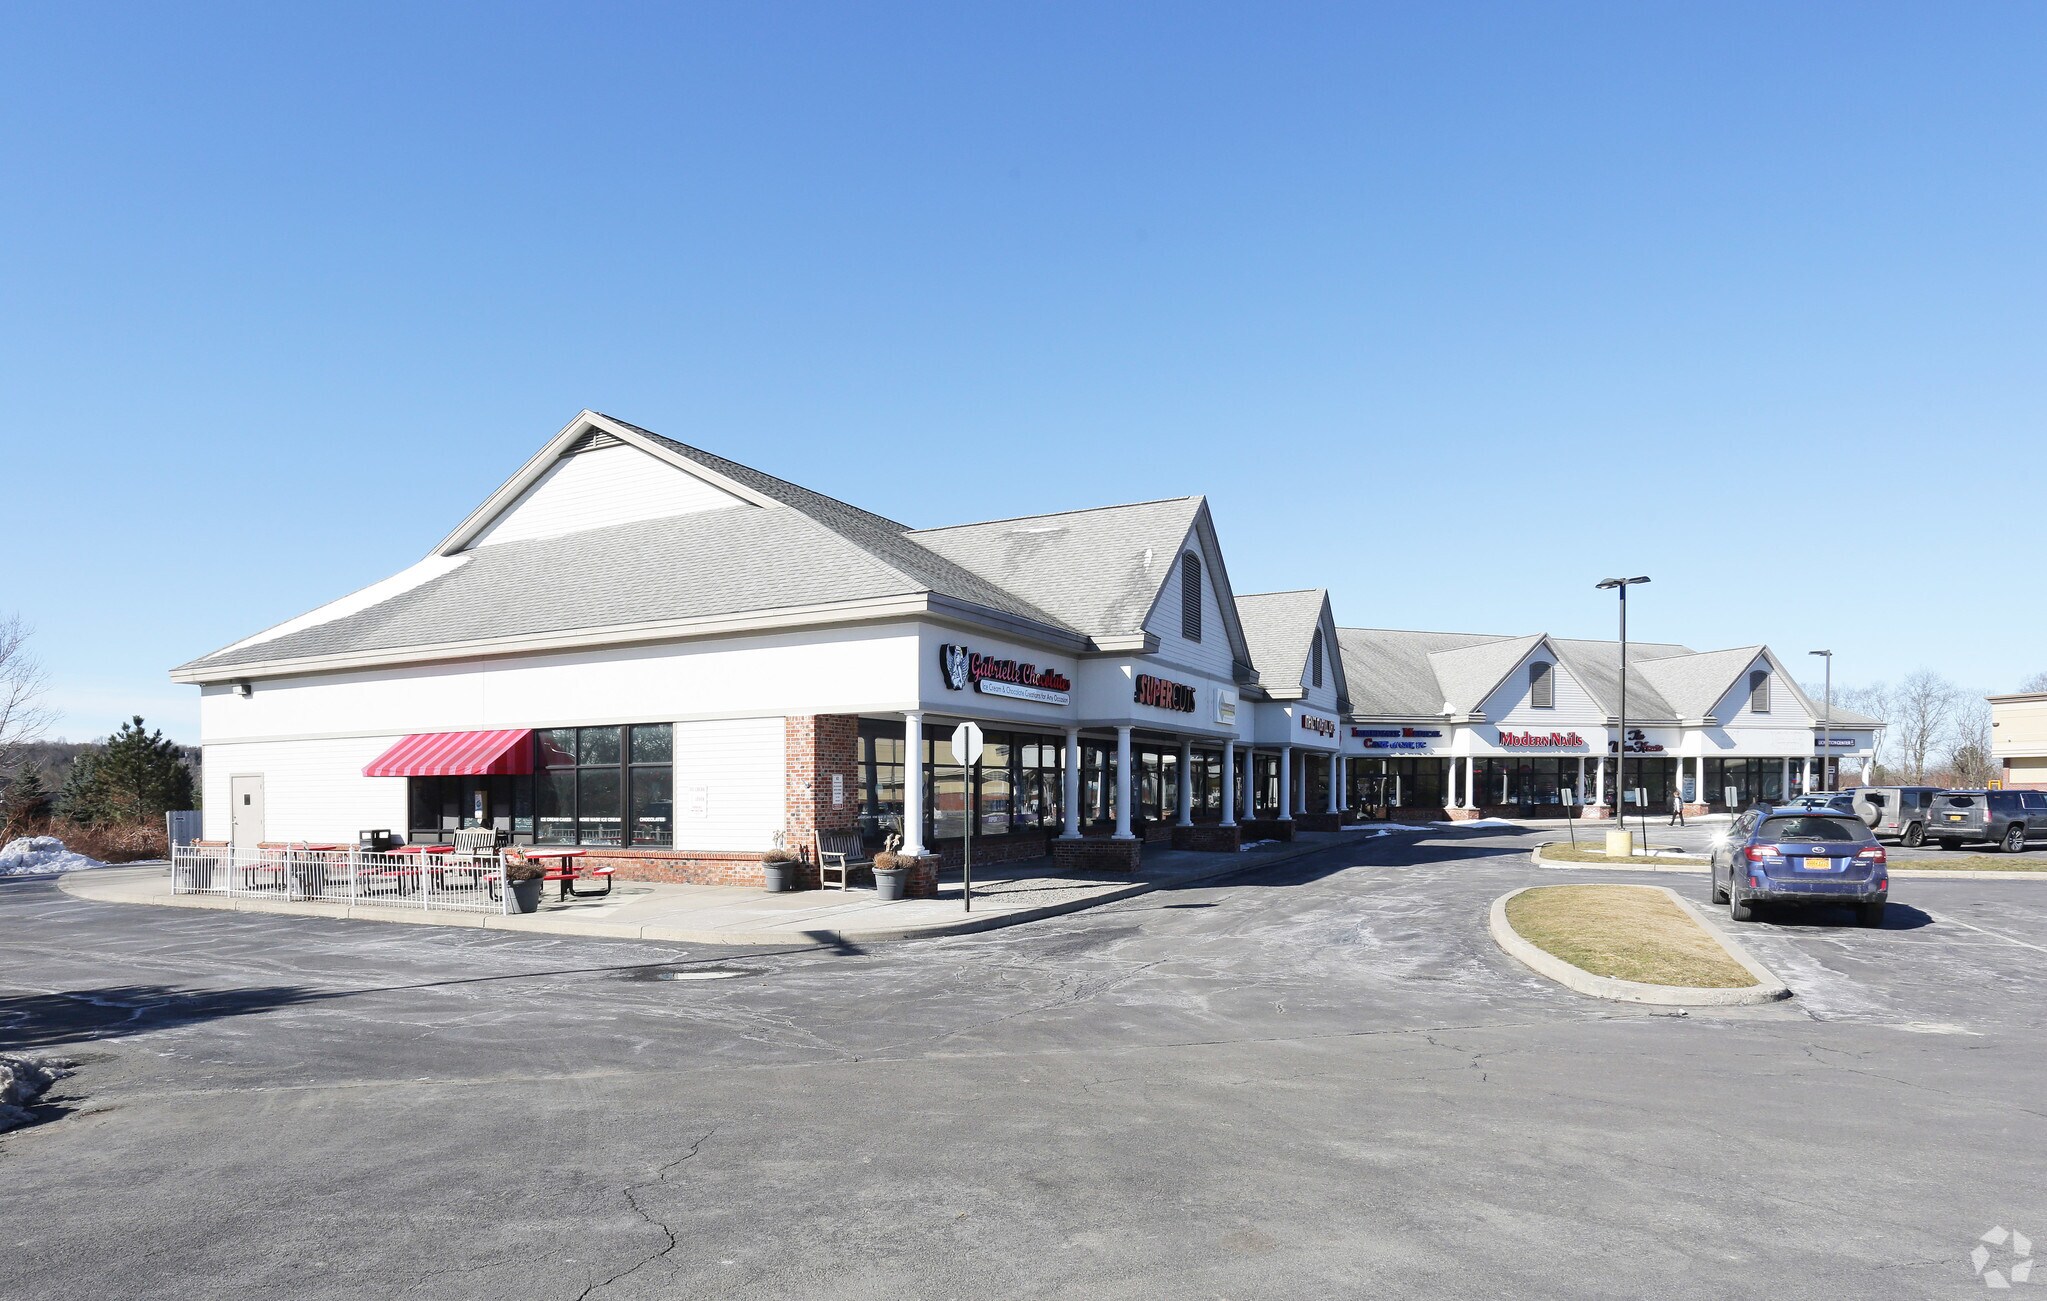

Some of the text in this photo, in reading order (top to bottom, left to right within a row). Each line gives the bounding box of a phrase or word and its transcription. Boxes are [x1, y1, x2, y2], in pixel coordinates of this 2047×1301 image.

[971, 652, 1020, 682] Gabrielle
[1138, 674, 1196, 713] SUPERCUTS
[1550, 732, 1583, 747] Nails
